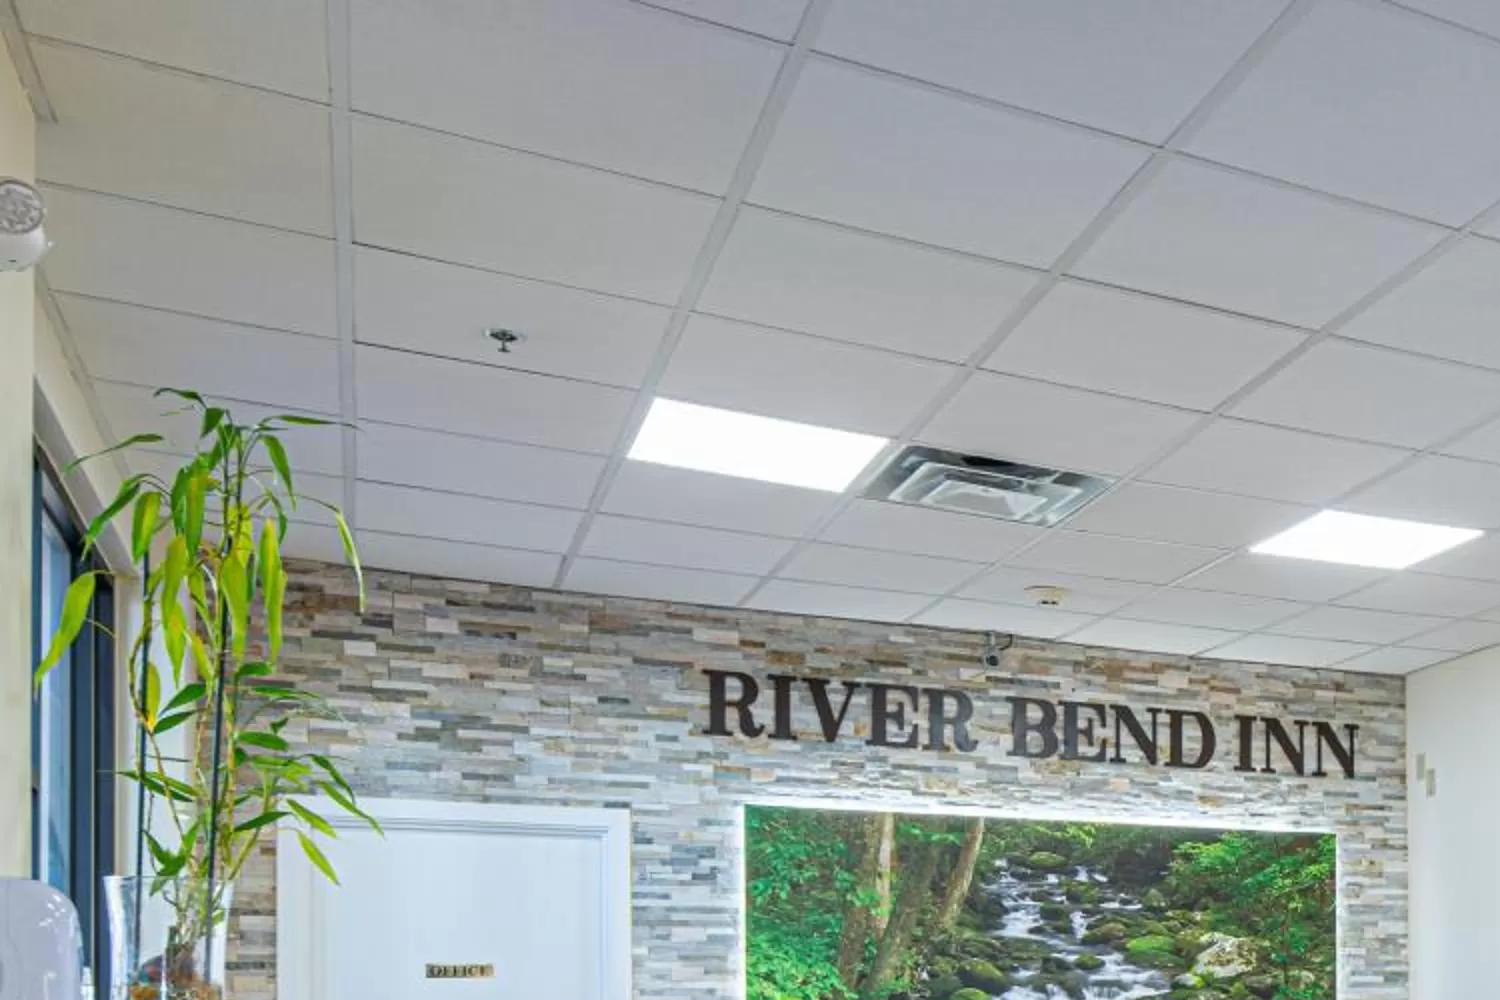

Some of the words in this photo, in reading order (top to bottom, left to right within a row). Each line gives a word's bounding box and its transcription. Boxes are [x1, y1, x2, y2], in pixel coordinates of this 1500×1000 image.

[701, 668, 978, 753] RIVER
[1005, 695, 1216, 769] BEND
[1232, 714, 1359, 778] INN
[429, 964, 489, 977] OFFICE
